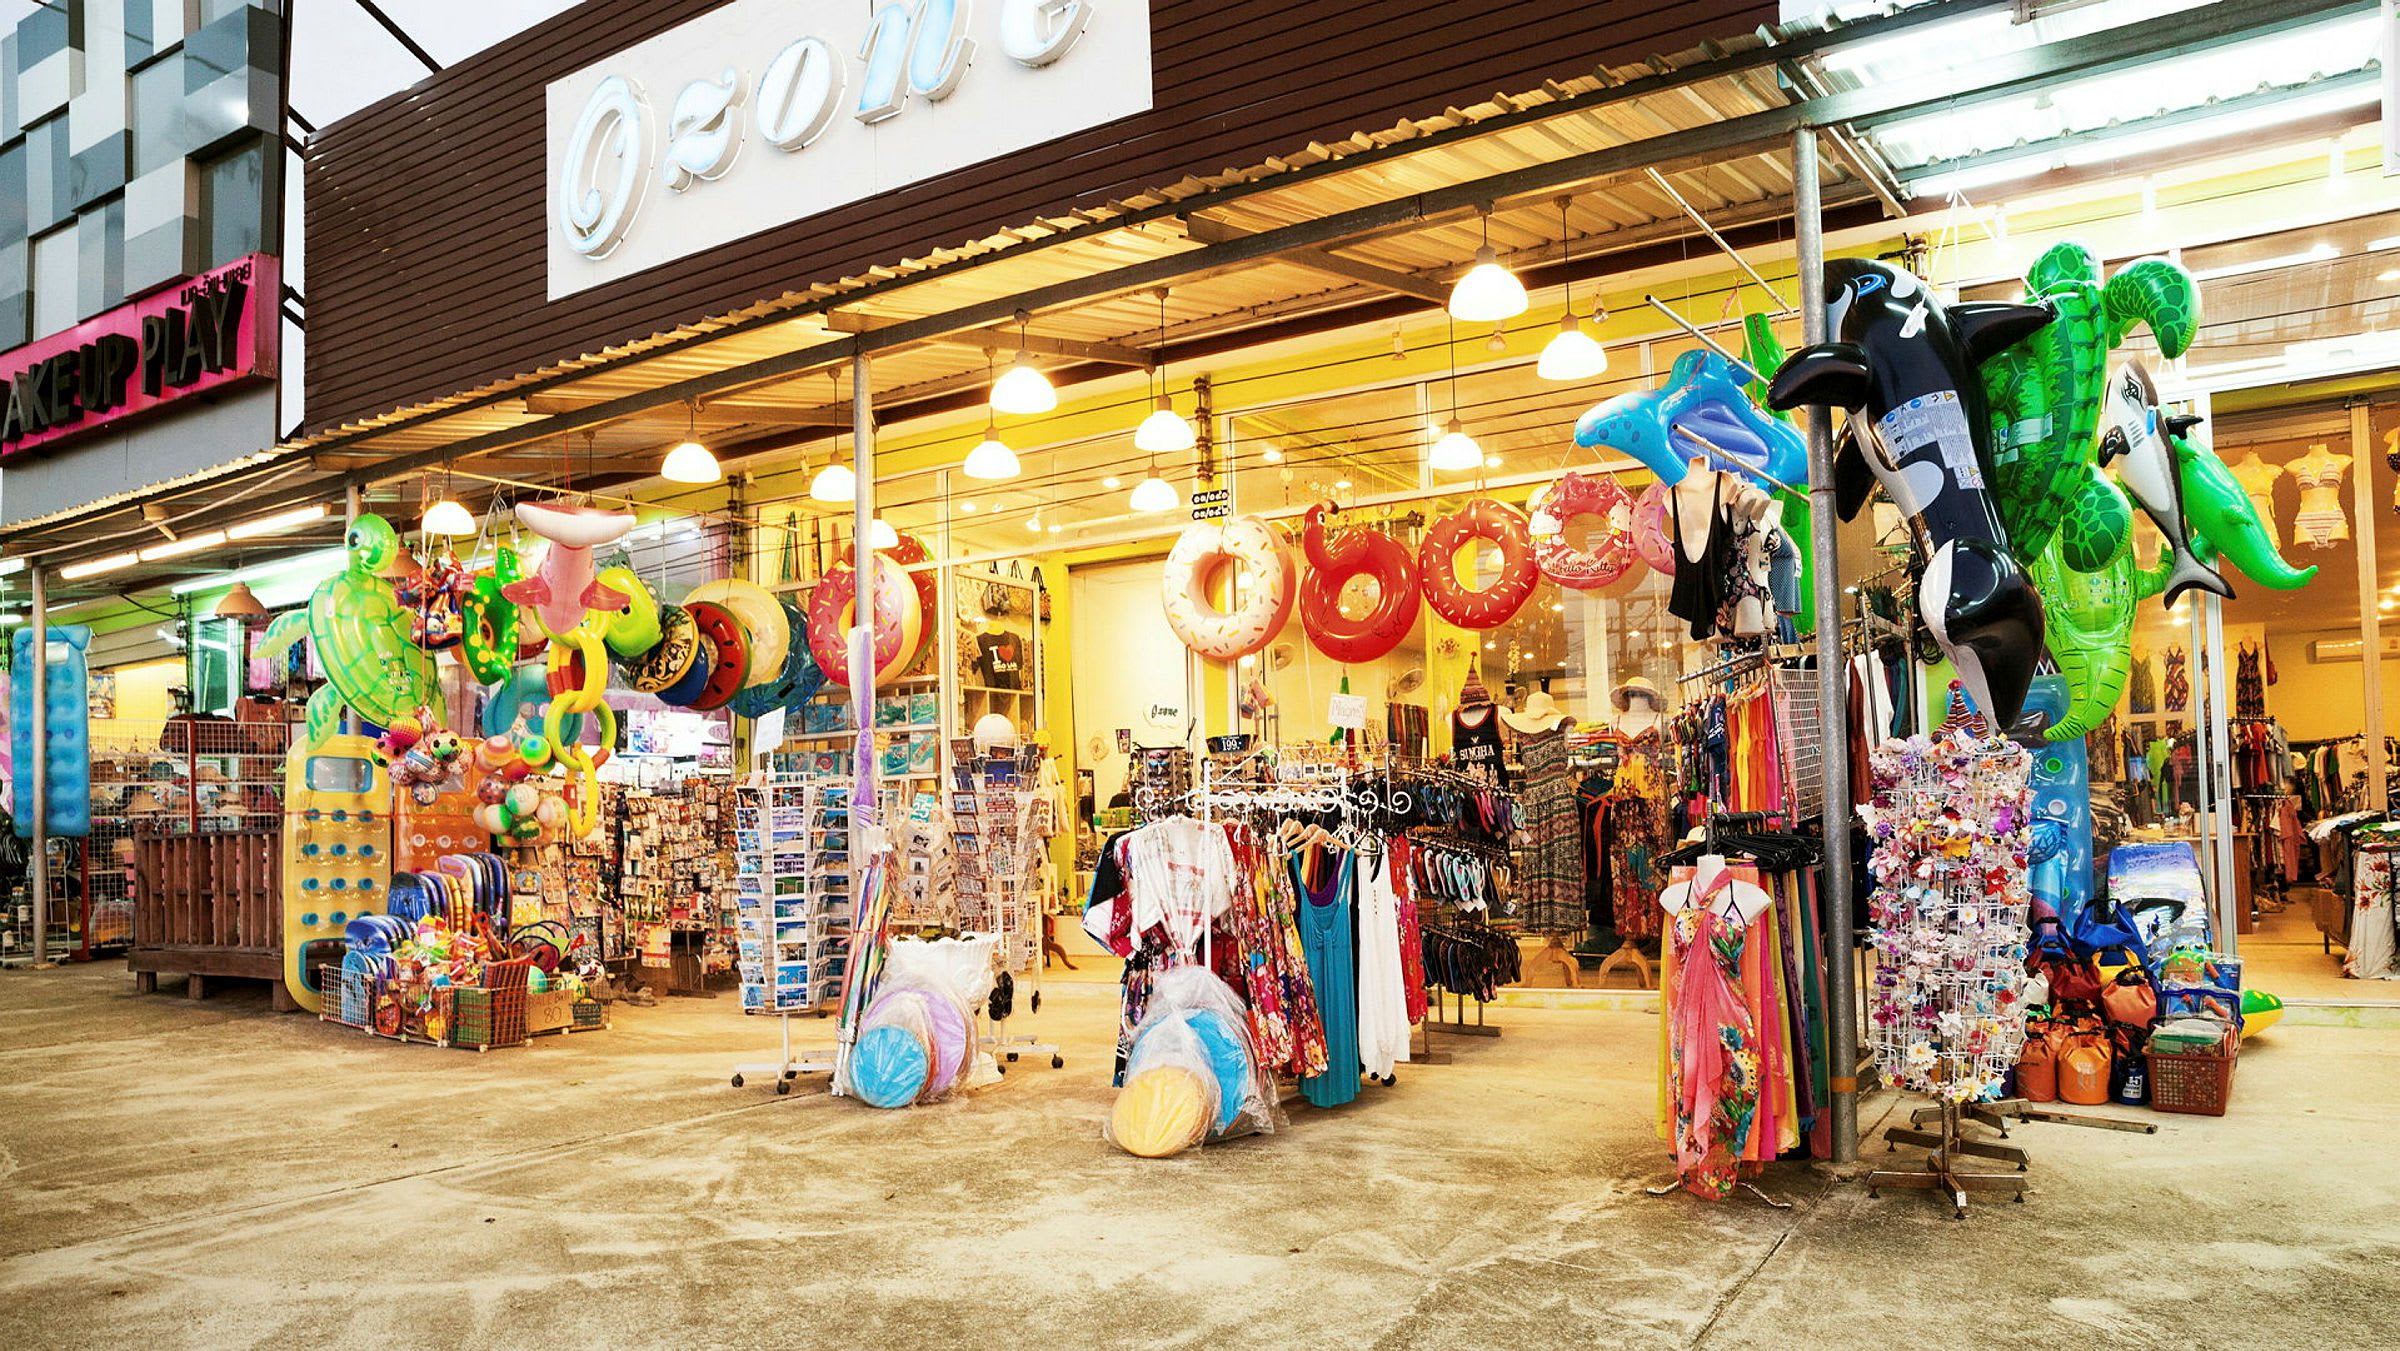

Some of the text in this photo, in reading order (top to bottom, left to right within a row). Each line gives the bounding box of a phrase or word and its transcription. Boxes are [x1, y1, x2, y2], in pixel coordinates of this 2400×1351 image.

[560, 0, 1093, 262] Ozone
[0, 279, 248, 444] AKE UP PLAY
[1585, 558, 1616, 574] Kitty
[989, 645, 1001, 664] I
[1151, 704, 1178, 719] Ozone
[1460, 744, 1496, 760] SINGHA
[543, 1006, 561, 1023] 80
